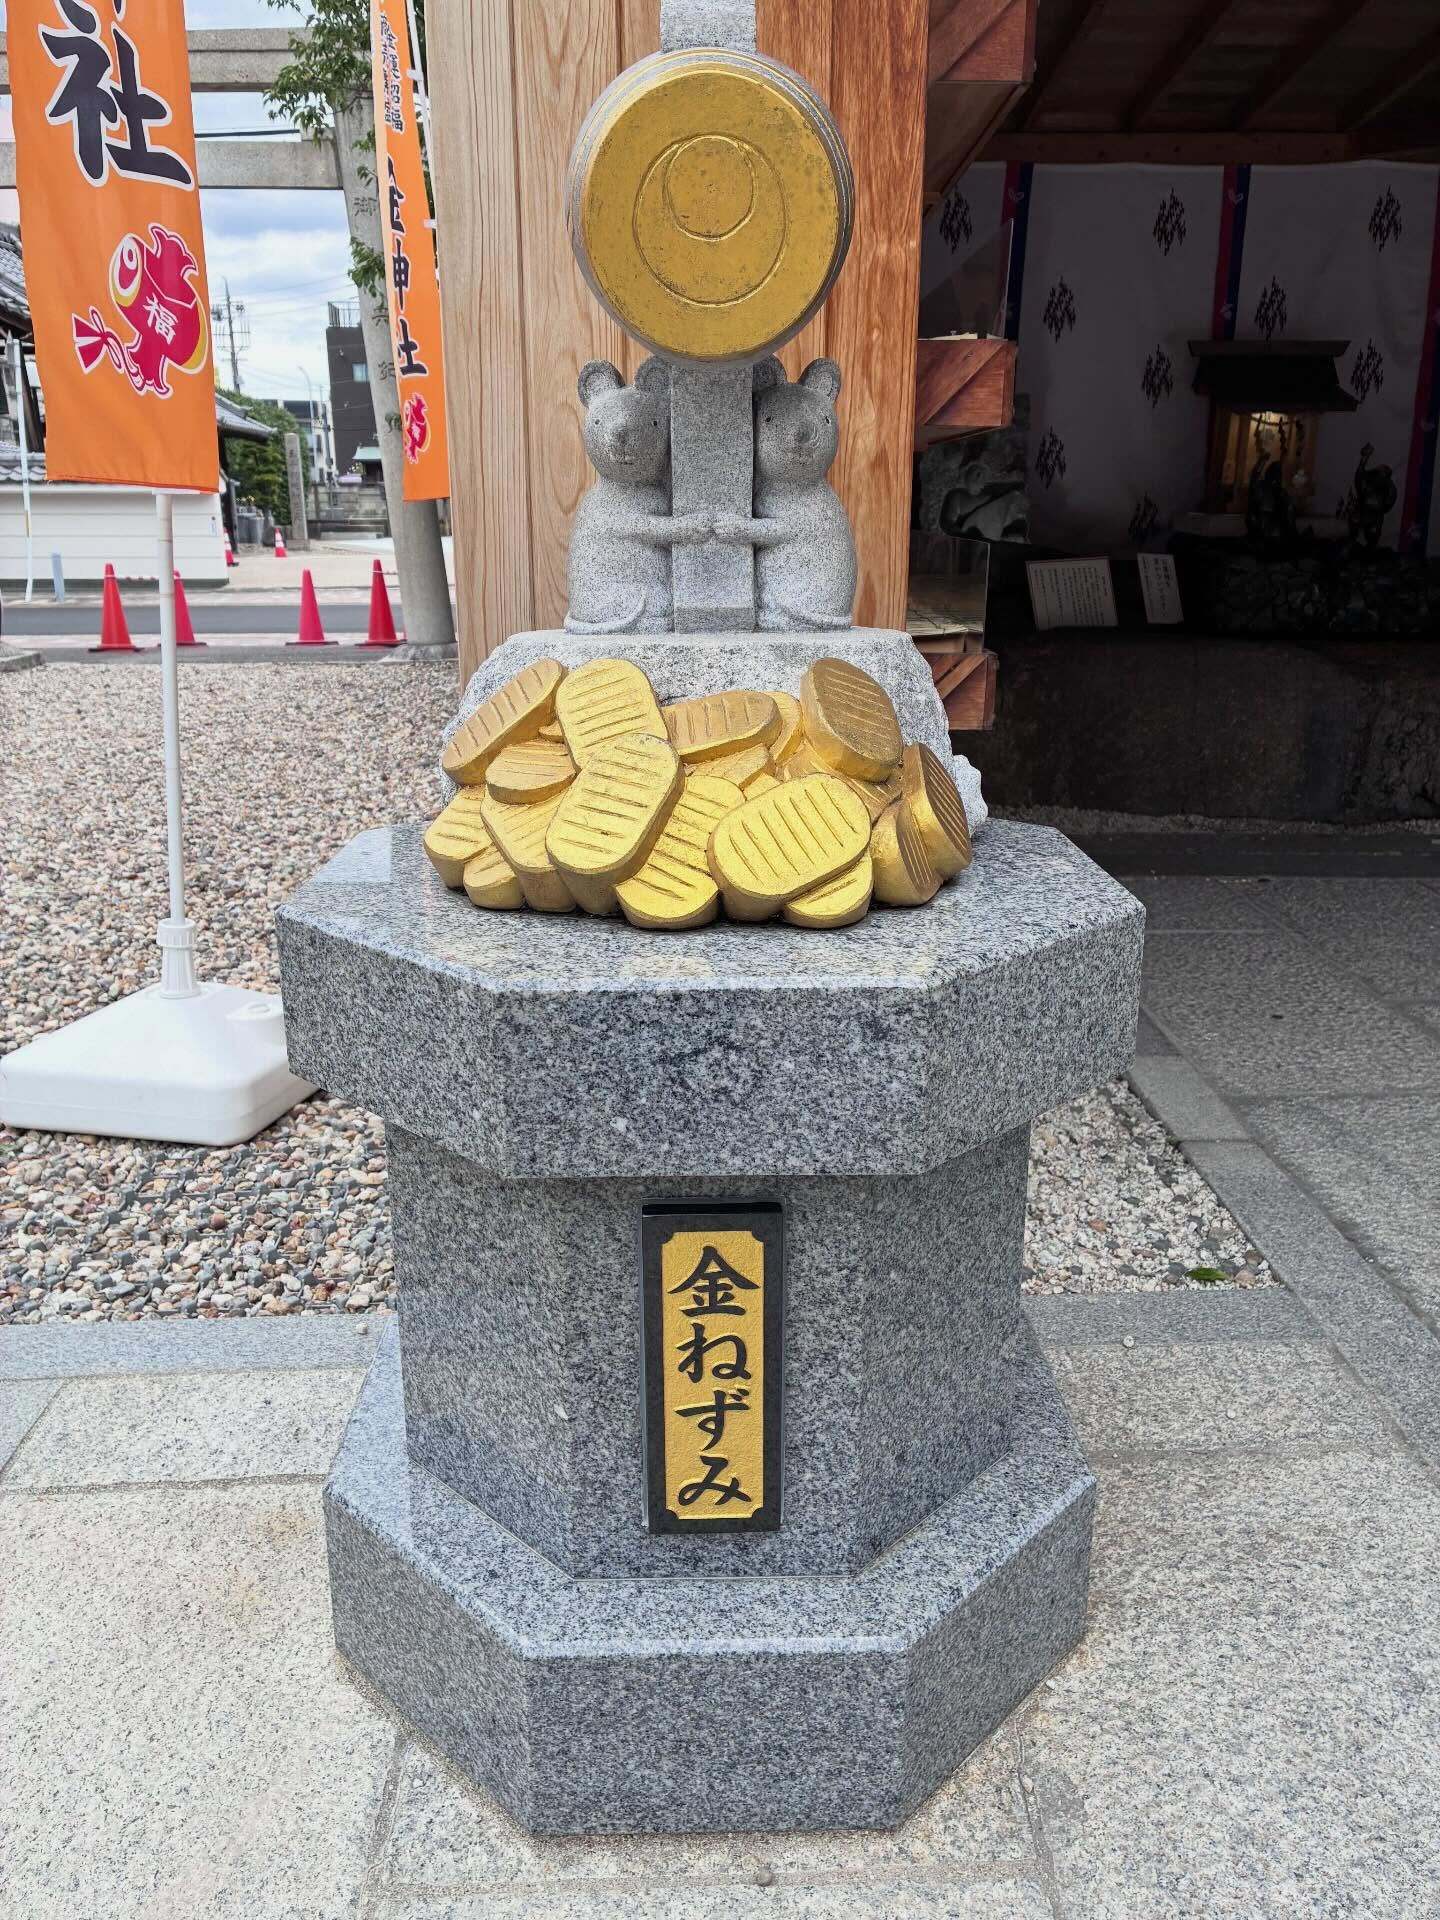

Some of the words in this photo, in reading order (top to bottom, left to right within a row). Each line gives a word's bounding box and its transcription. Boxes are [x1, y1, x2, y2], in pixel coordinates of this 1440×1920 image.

[142, 295, 181, 347] 福
[666, 1245, 761, 1507] 金ねずみ
